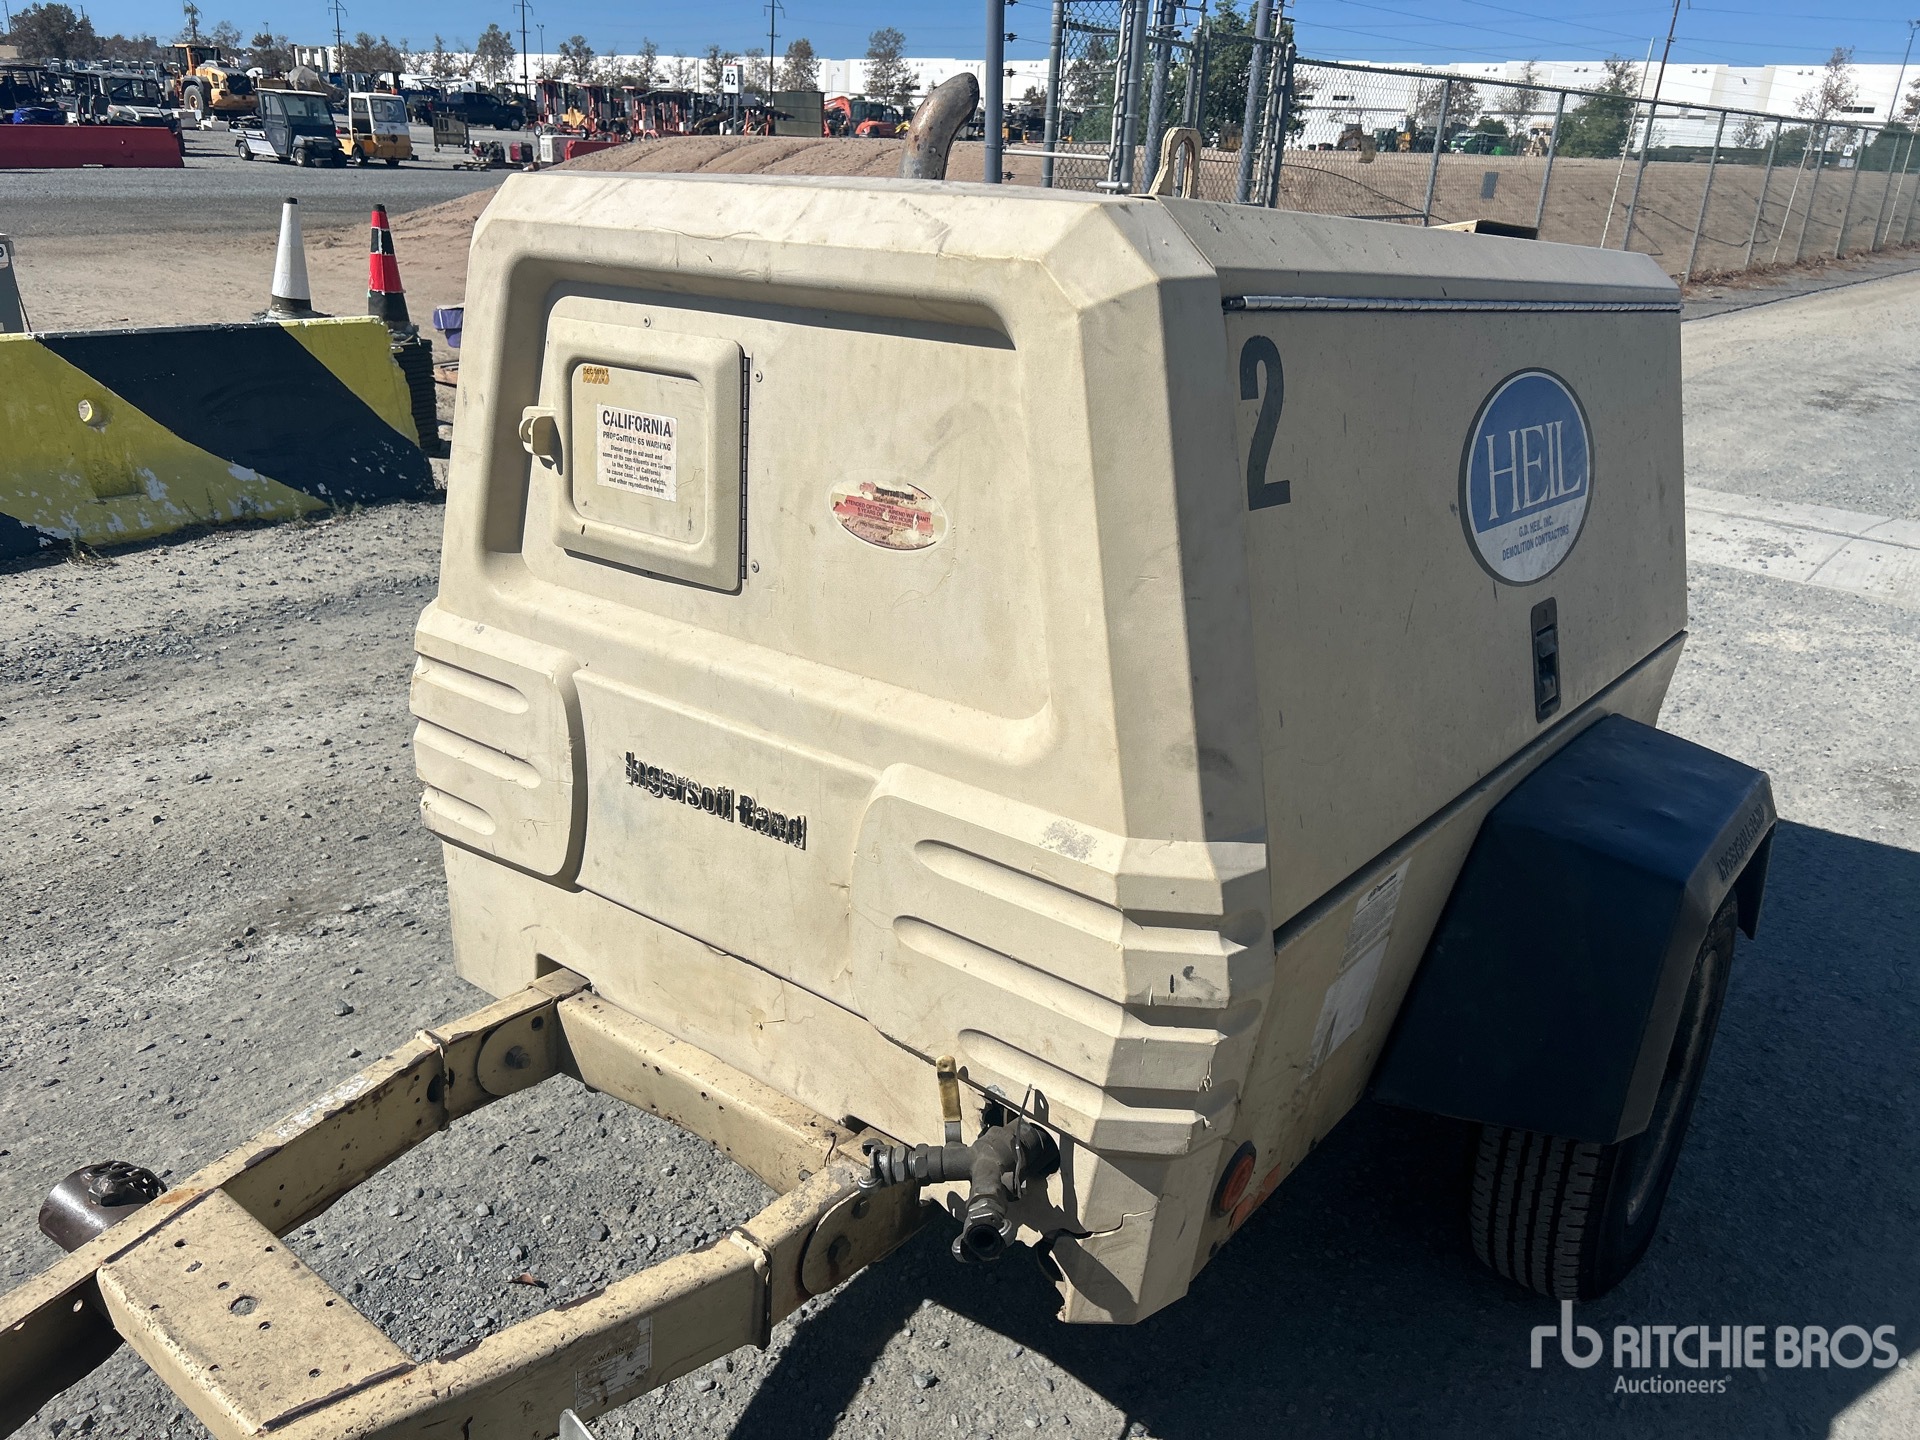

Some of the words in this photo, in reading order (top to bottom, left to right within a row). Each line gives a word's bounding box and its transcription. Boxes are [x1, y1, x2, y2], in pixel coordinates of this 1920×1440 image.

[725, 73, 736, 86] 42
[602, 410, 674, 438] CALIFORNIA
[1239, 335, 1292, 511] 2
[637, 437, 645, 446] 65
[641, 467, 662, 477] California
[1486, 420, 1581, 521] HEIL
[617, 478, 628, 486] other
[845, 499, 866, 509] XTENDED
[865, 503, 885, 513] OPTIONA
[1502, 538, 1535, 561] DEMOLITION
[1534, 524, 1570, 548] CONTRACTORS
[626, 751, 735, 823] Ingersoll
[737, 793, 807, 851] Rand
